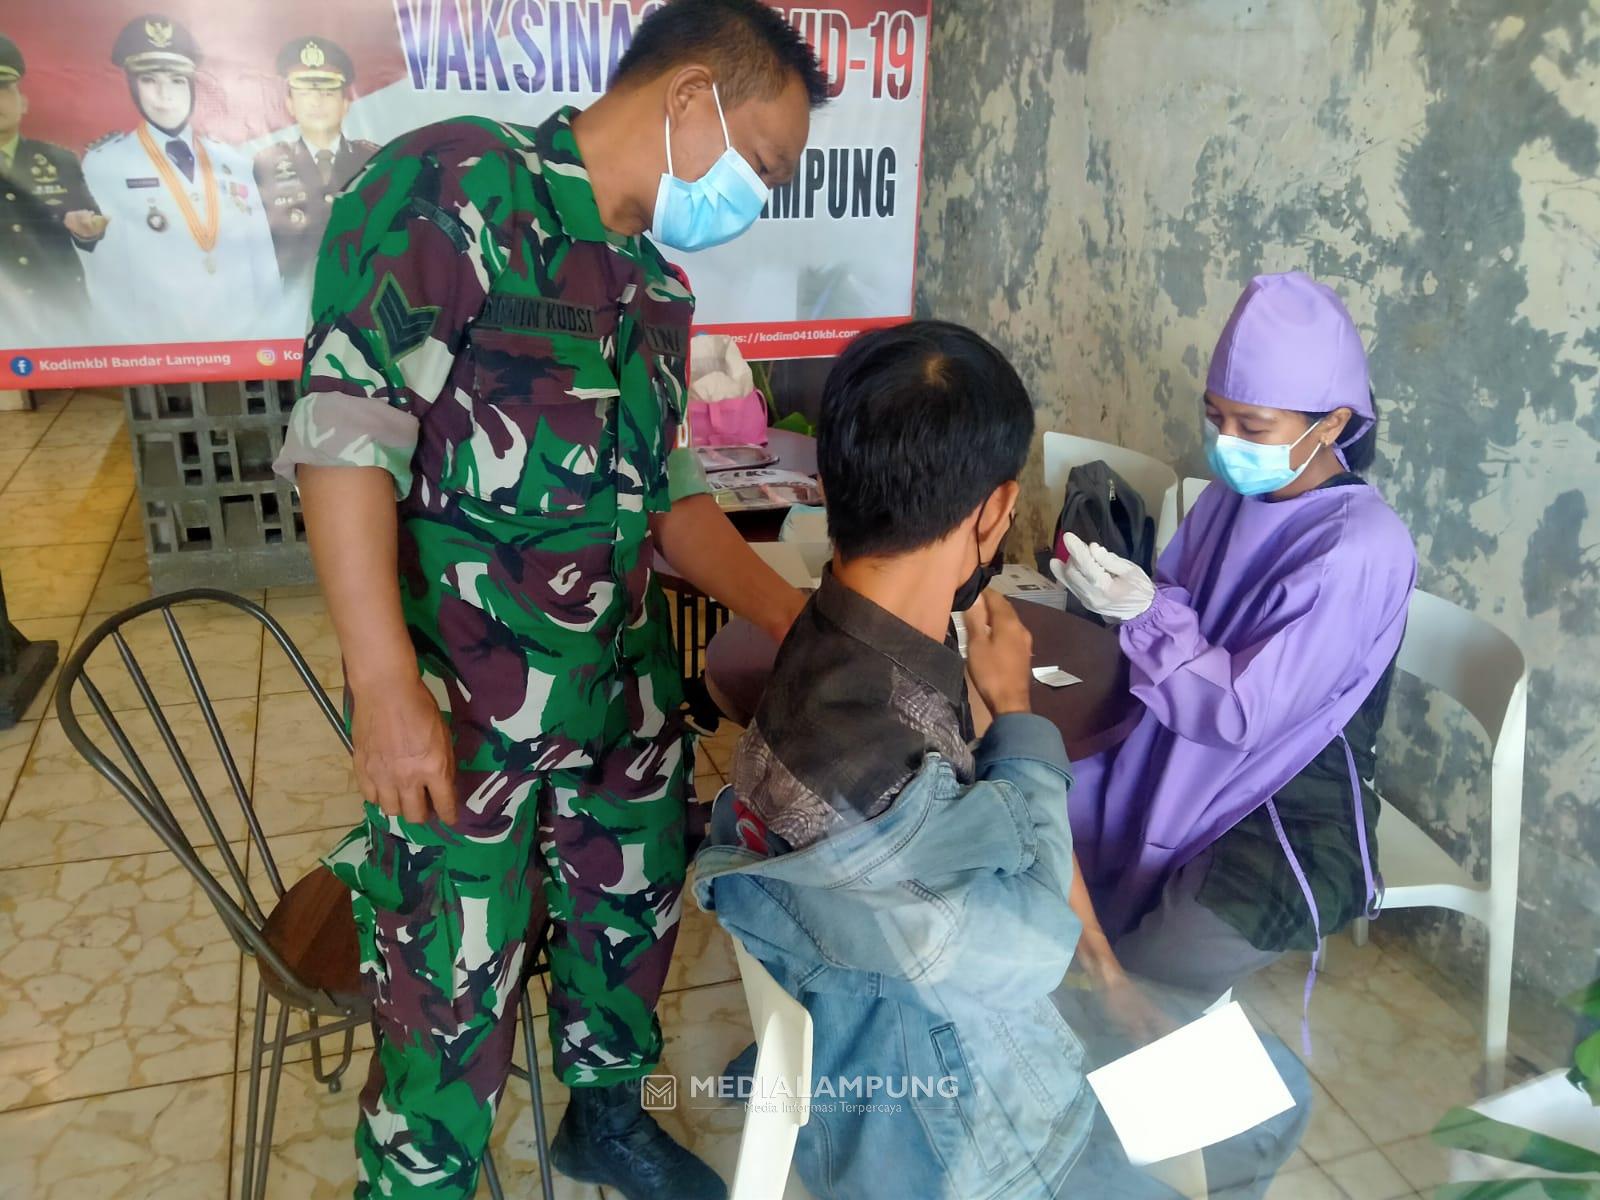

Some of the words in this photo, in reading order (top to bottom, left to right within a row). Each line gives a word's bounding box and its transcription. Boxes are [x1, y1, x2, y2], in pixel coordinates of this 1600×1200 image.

[396, 0, 665, 94] VAKSINA
[759, 147, 896, 219] MPUNG
[546, 303, 593, 333] KUDSI
[39, 357, 108, 372] Kodimkbl
[111, 355, 163, 368] Bandar
[166, 352, 231, 366] Lampung
[283, 350, 303, 361] Ko
